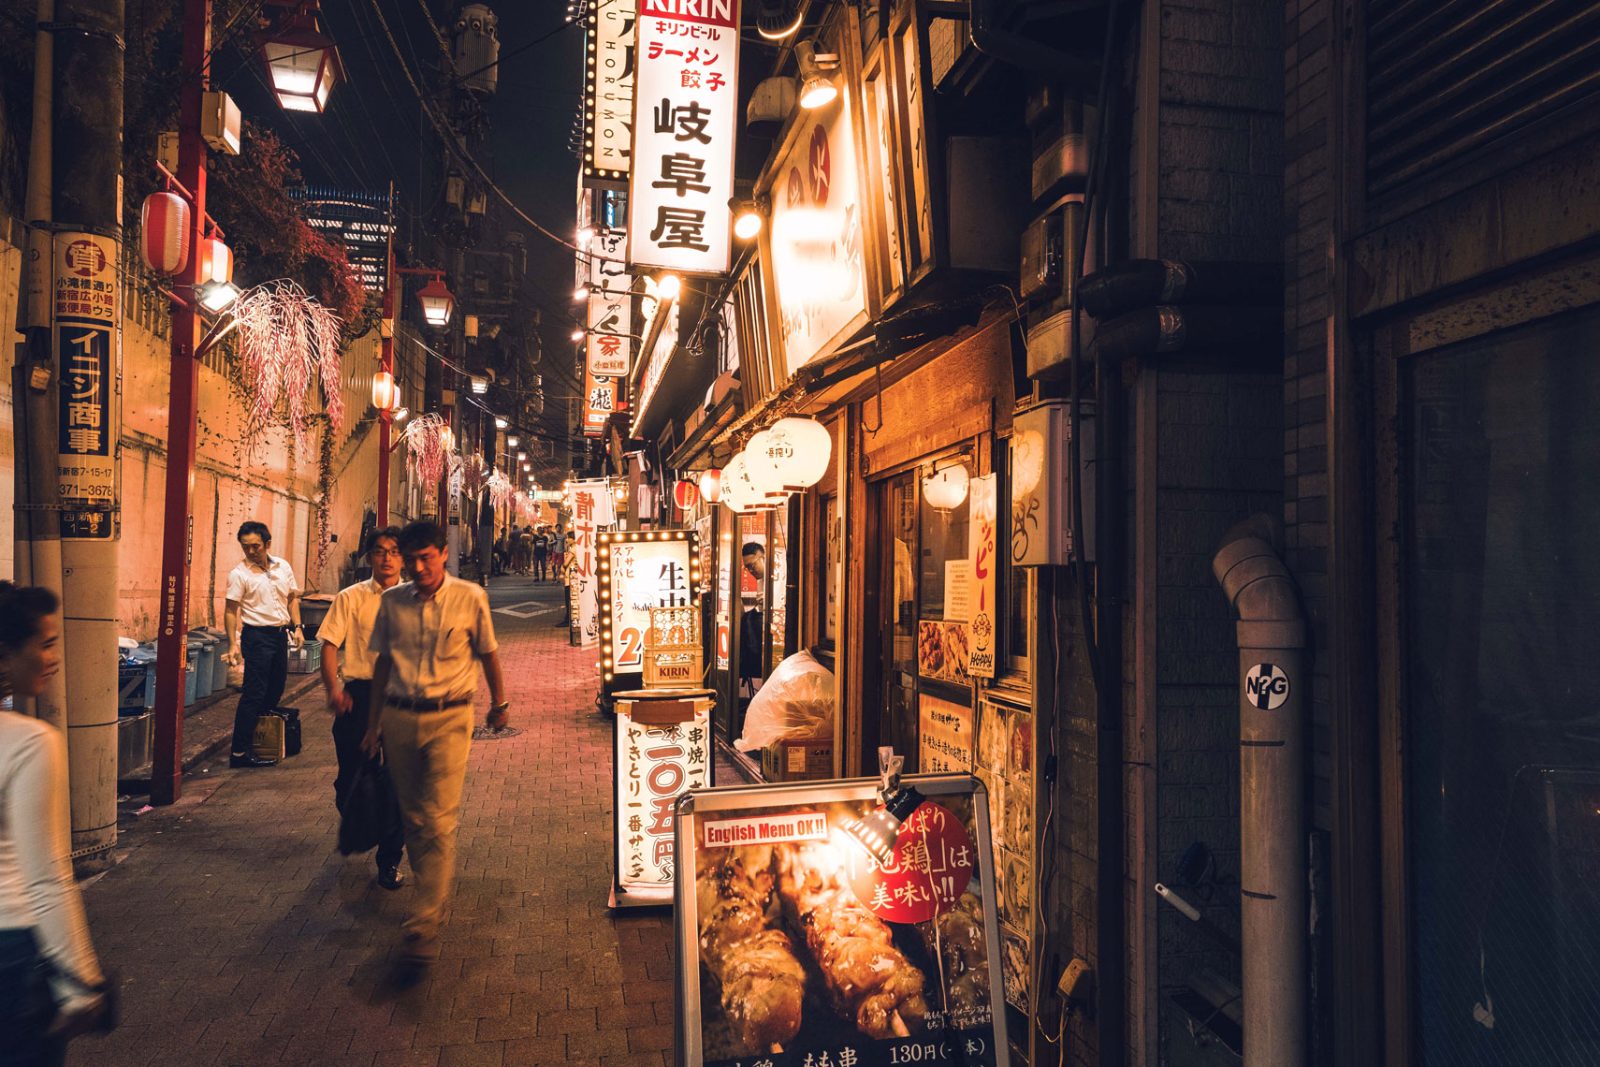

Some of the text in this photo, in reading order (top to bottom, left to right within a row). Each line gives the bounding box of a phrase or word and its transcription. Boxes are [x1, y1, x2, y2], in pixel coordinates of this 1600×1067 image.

[655, 21, 721, 41] キリンビール
[648, 41, 719, 66] ラーメン
[681, 69, 726, 92] 餃子
[603, 41, 616, 157] HORUMON
[650, 97, 713, 253] 岐阜屋
[68, 243, 102, 273] 質
[624, 546, 635, 579] アサヒ
[659, 667, 690, 677] KIRIN
[707, 824, 756, 844] English
[758, 822, 795, 839] Menu
